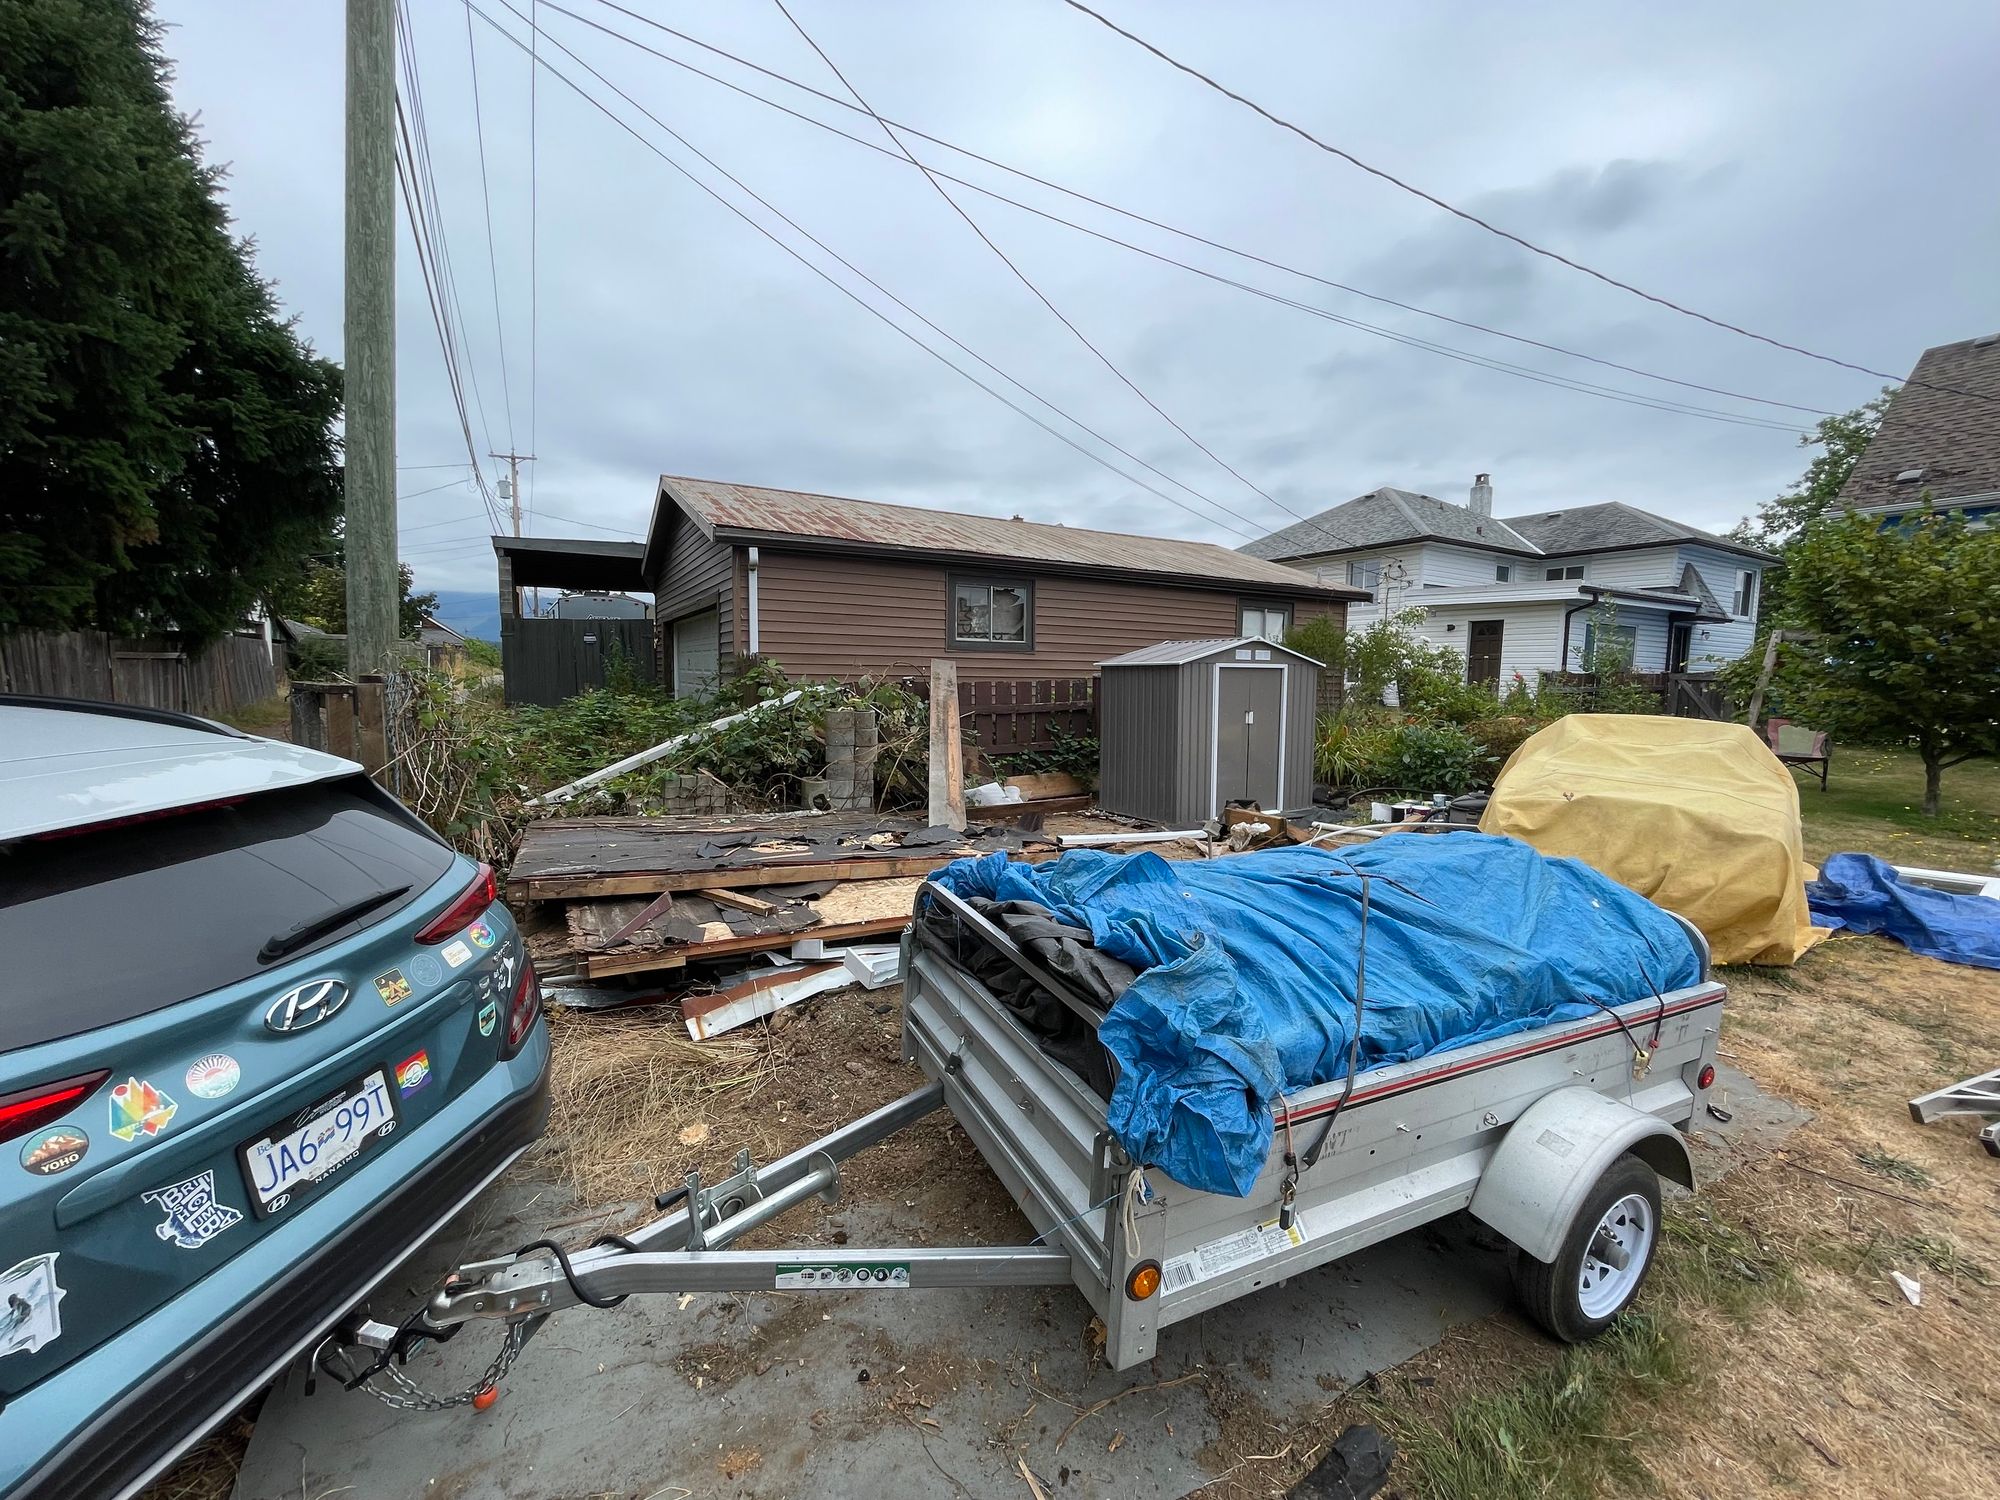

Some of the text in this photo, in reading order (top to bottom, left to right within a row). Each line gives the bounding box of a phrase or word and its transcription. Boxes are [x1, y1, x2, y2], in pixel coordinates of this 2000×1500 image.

[260, 1129, 318, 1192] JA6
[335, 1084, 384, 1143] 99T
[40, 1153, 79, 1173] YOHO
[315, 1150, 360, 1184] NANAIMO
